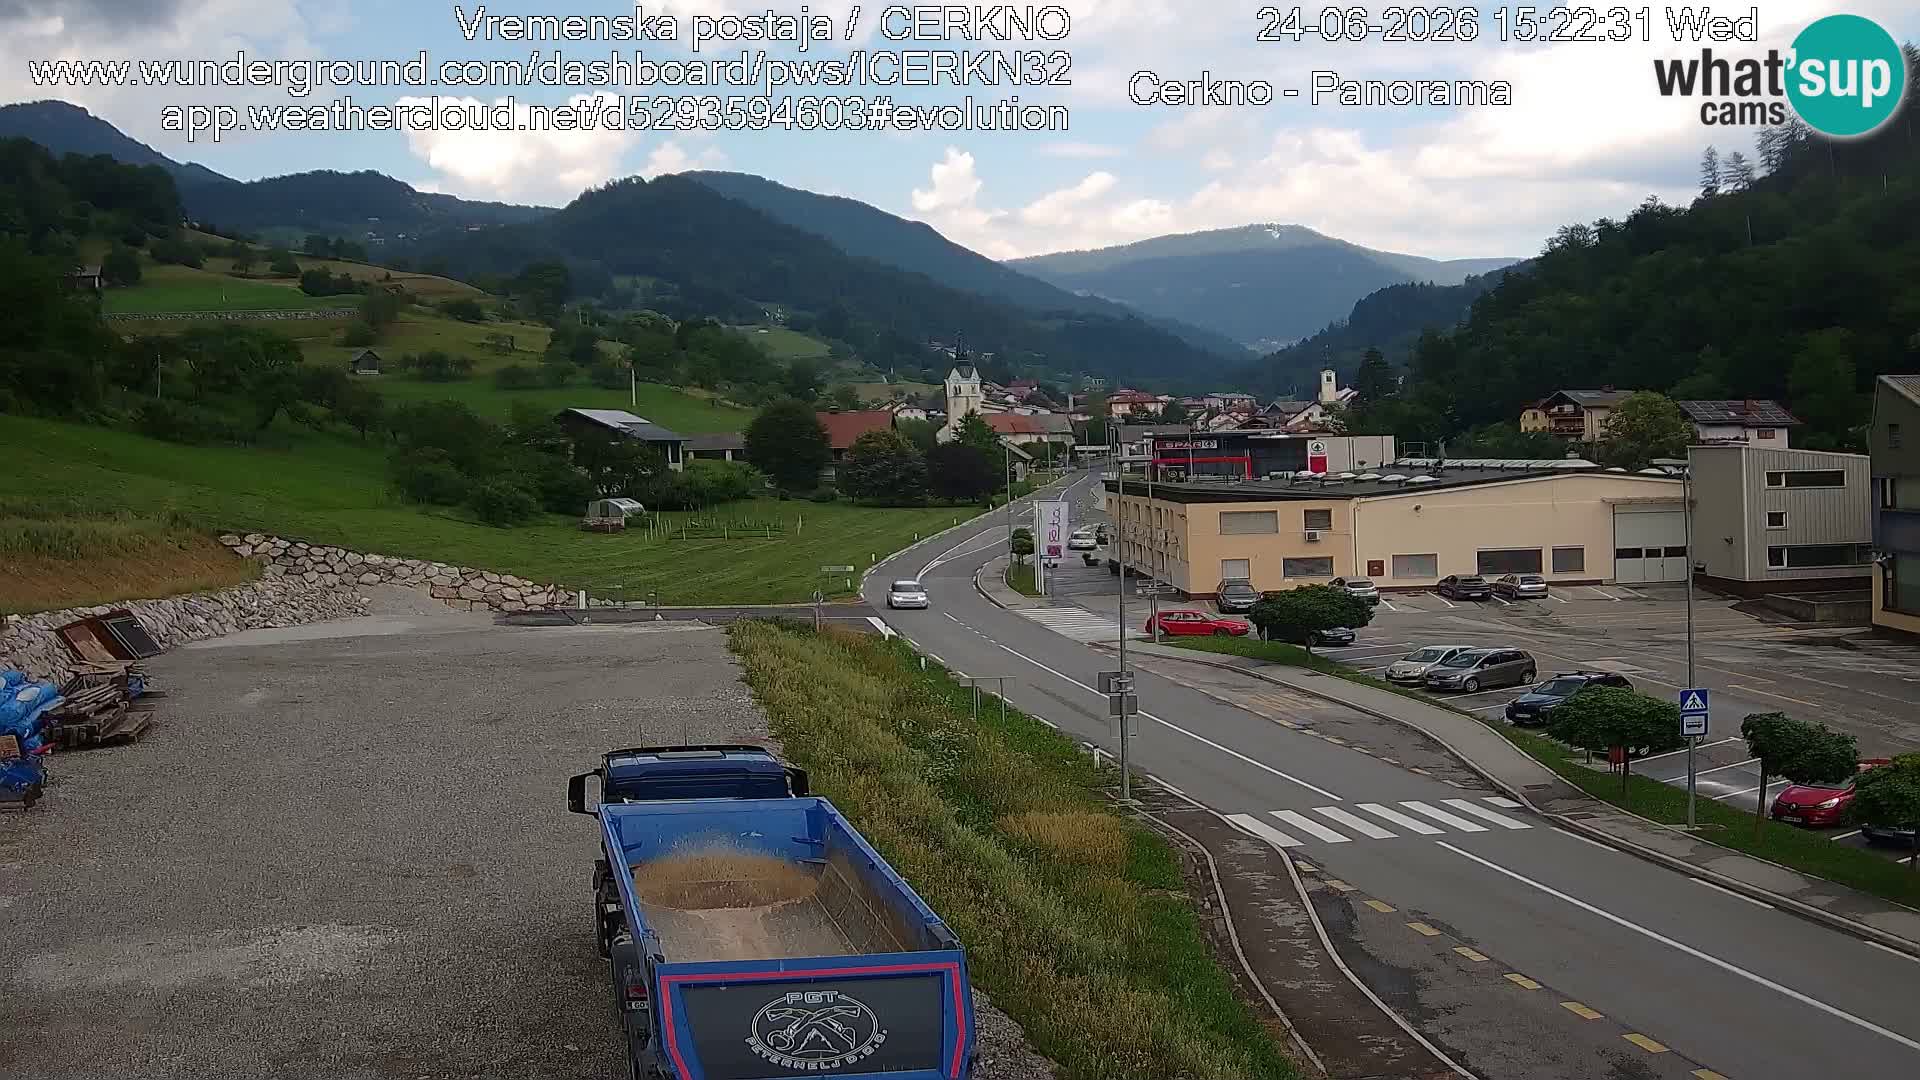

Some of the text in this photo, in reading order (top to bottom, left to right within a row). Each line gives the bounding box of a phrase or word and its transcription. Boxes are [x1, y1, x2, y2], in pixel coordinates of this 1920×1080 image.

[1165, 441, 1201, 449] SPAR
[786, 990, 839, 1005] PGT
[745, 1036, 841, 1070] PETERNELJ
